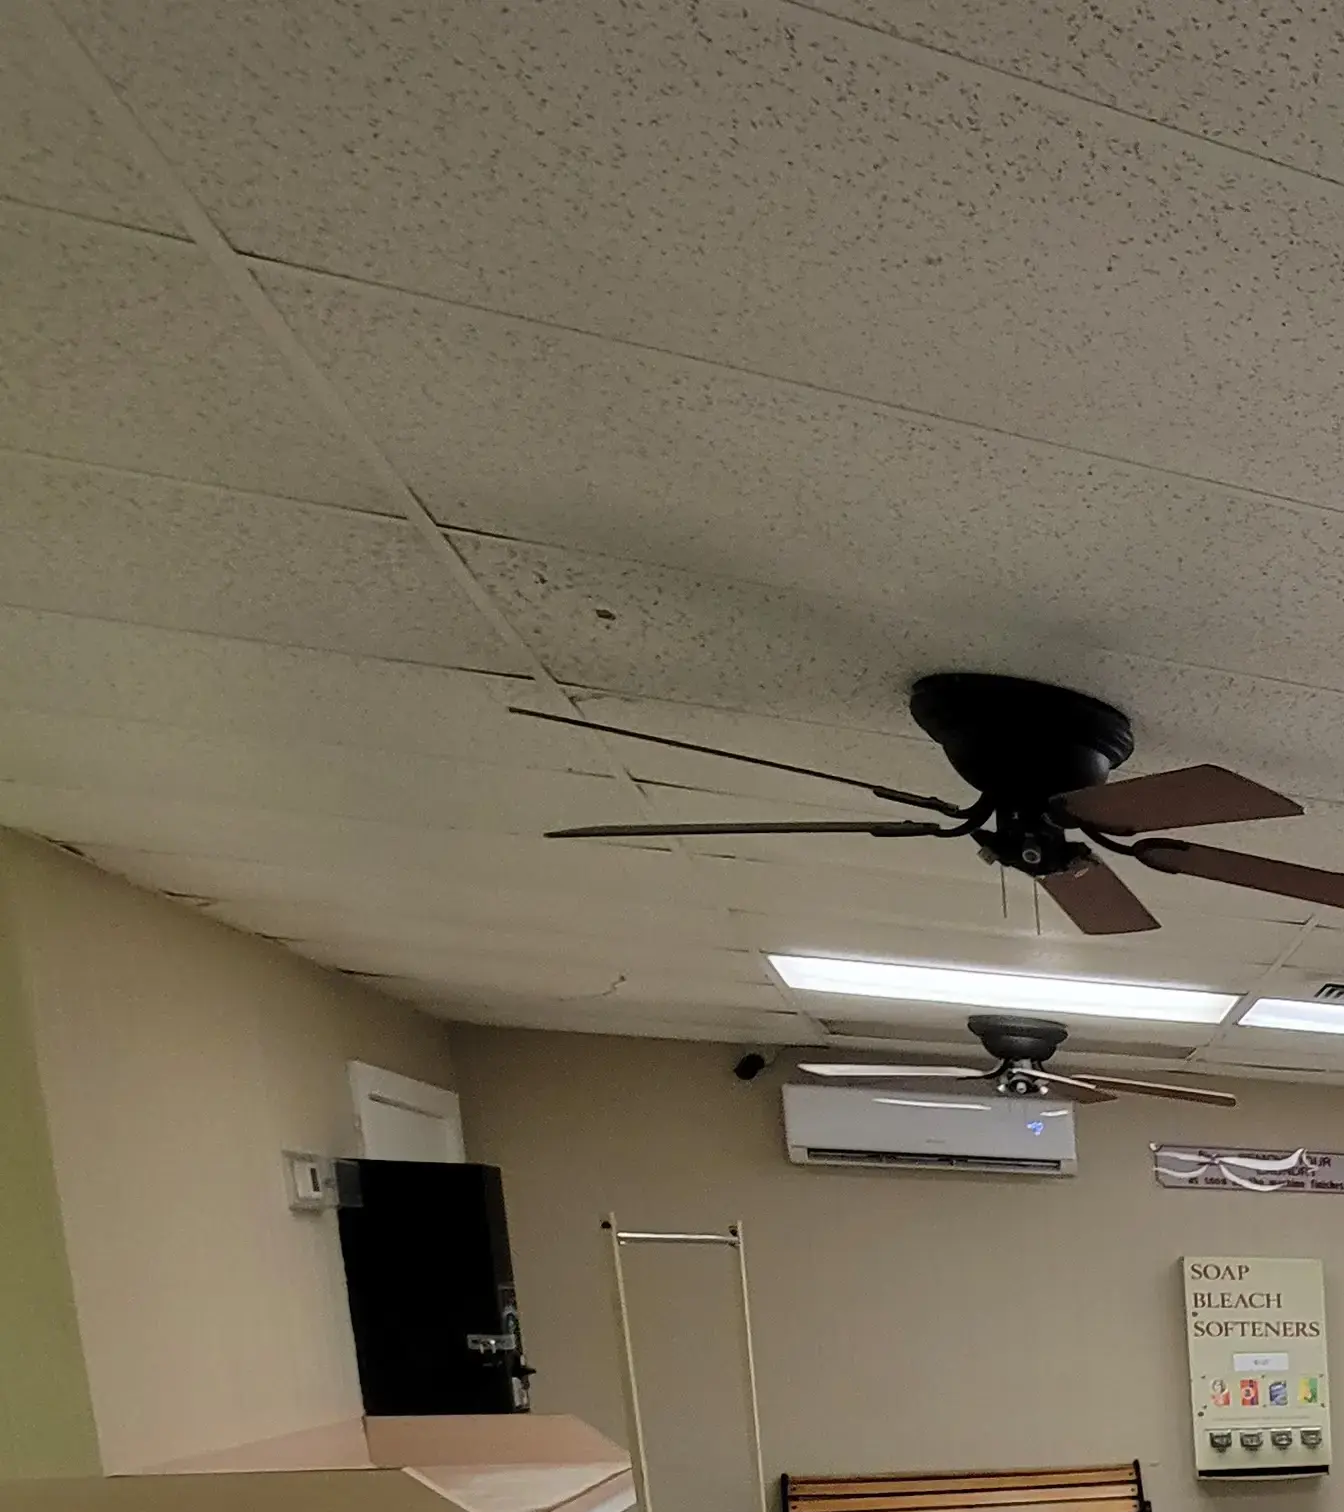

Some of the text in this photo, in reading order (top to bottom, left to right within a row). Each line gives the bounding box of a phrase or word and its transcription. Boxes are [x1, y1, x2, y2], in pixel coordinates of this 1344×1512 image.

[1190, 1263, 1251, 1281] SOAP
[1193, 1293, 1282, 1310] BLEACH
[1193, 1321, 1321, 1338] SOFTENERS
